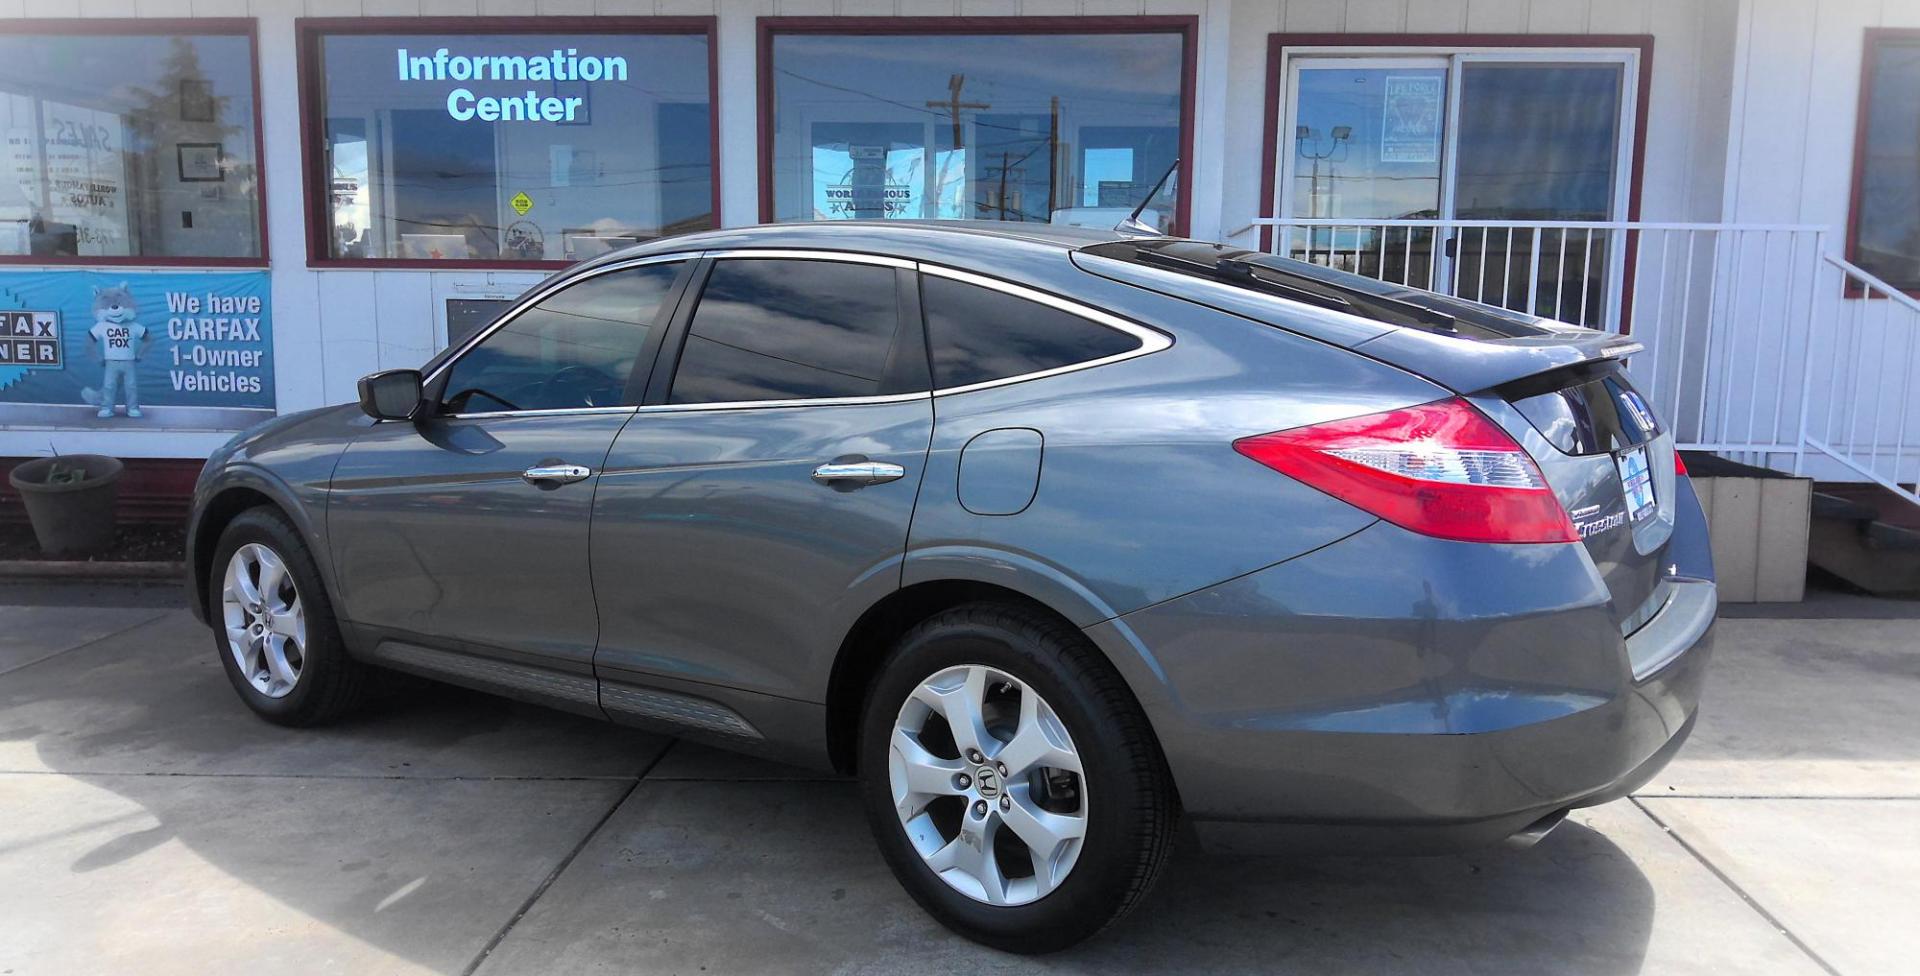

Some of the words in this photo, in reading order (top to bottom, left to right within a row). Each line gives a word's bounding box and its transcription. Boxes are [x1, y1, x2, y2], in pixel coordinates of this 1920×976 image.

[397, 48, 628, 82] Information
[446, 88, 582, 122] Center
[825, 190, 853, 198] WOR
[166, 292, 200, 314] We
[207, 293, 261, 313] have
[106, 327, 130, 338] CAR
[168, 318, 261, 341] CARFAX
[108, 338, 130, 349] FOX
[170, 345, 263, 367] 1-Owner
[170, 370, 261, 393] Vehicles
